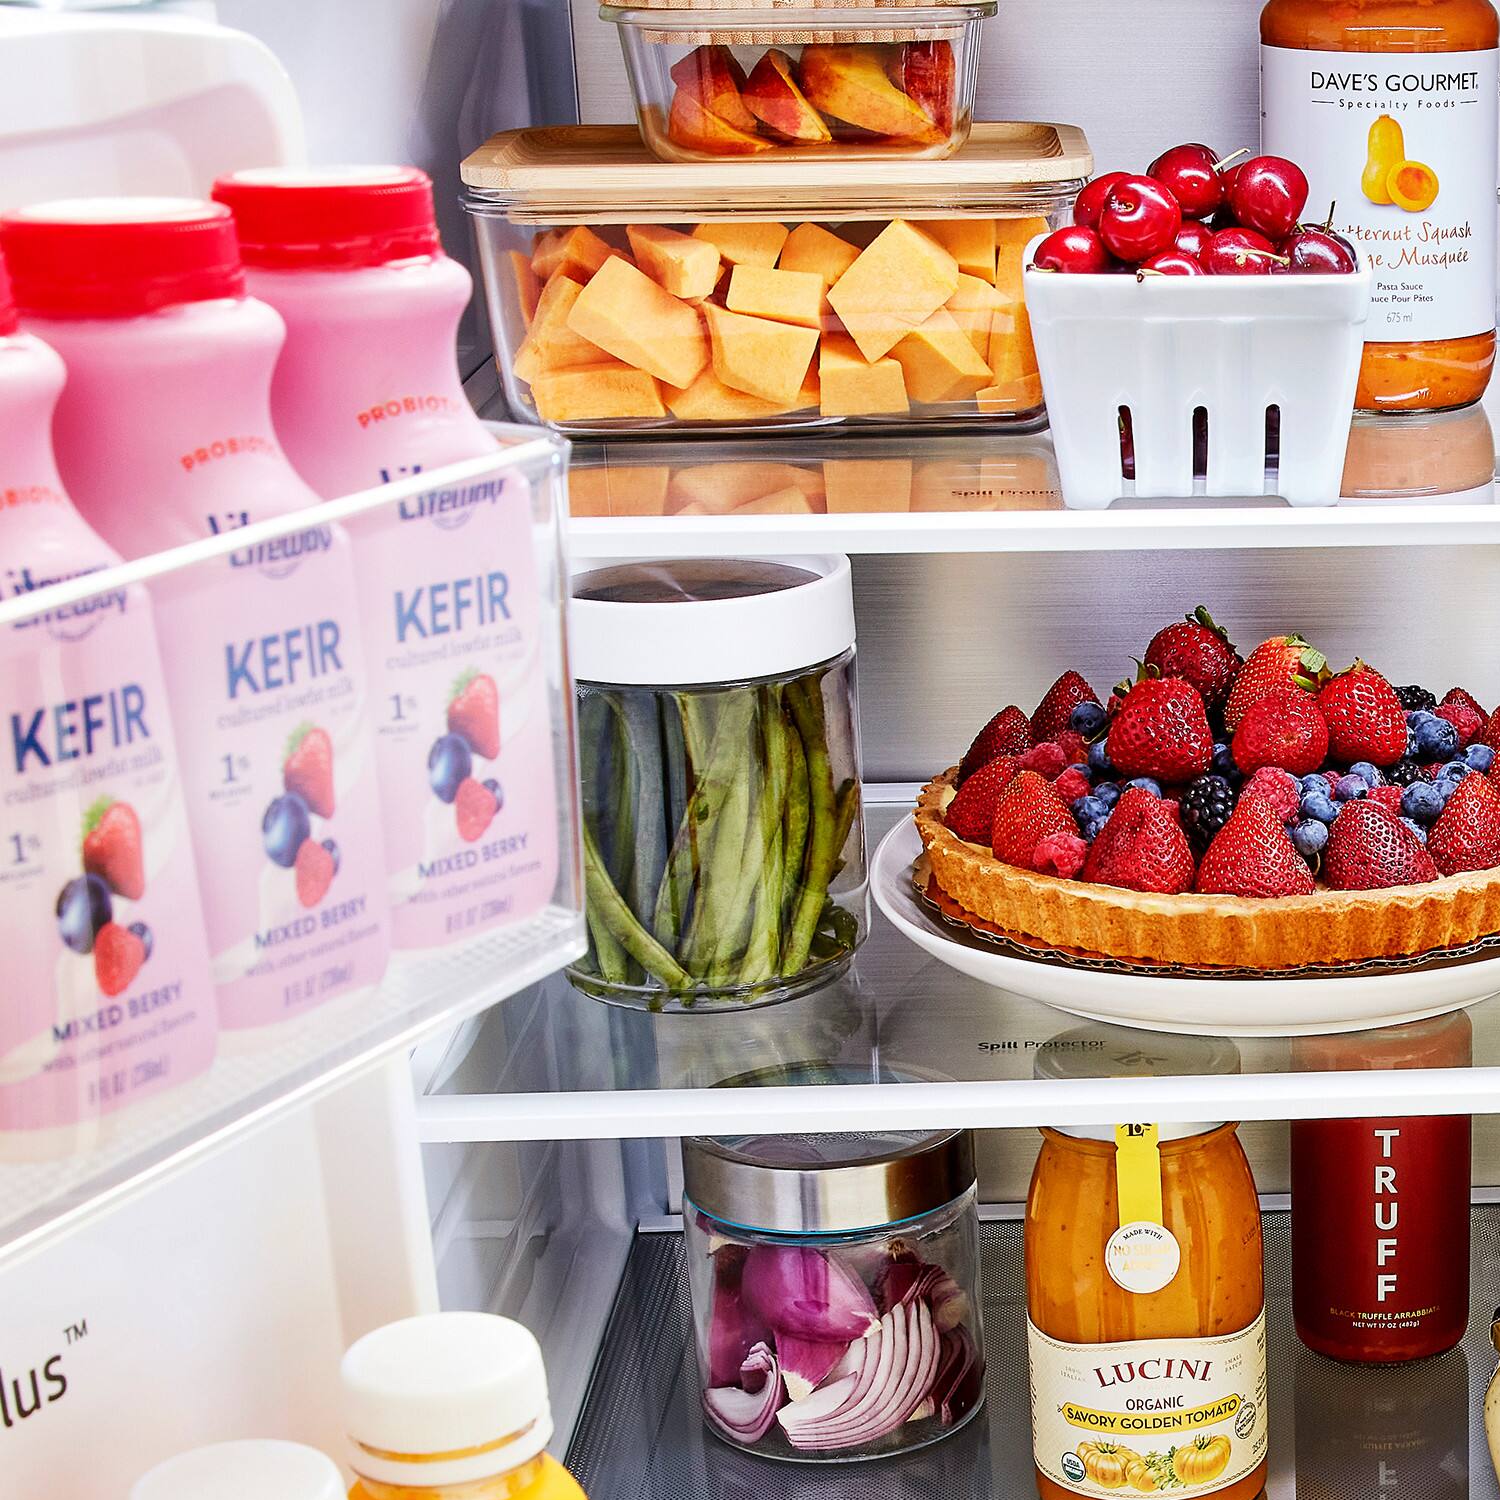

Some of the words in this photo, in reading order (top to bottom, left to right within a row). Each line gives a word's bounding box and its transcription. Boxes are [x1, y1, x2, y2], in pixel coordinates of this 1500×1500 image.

[1311, 71, 1378, 91] DAVE'S
[1339, 99, 1409, 110] Specialty
[1418, 99, 1455, 109] Foods
[1417, 221, 1472, 245] Squash
[1388, 247, 1469, 269] Musquée
[1377, 283, 1398, 291] Pasta
[1401, 282, 1424, 291] Sauce
[1391, 294, 1411, 303] Pour
[1387, 312, 1401, 323] 675
[394, 571, 511, 643] KEFIR
[225, 619, 343, 700] KEFIR
[10, 684, 150, 774] KEFIR
[418, 850, 478, 878] MIXED
[481, 832, 528, 862] BERRY
[52, 1004, 123, 1042] MIXED
[977, 1041, 1018, 1051] Spill
[1024, 1039, 1107, 1050] Protector
[1374, 1128, 1400, 1303] TRUFF
[1122, 1229, 1143, 1241] MADE
[1144, 1228, 1163, 1241] WITH
[1358, 1312, 1392, 1320] TRUFFLE
[1093, 1358, 1212, 1388] LUCINI
[0, 1355, 68, 1428] lus
[1067, 1407, 1117, 1428] SAVORY
[1120, 1415, 1183, 1430] GOLDEN
[1185, 1398, 1238, 1423] TOMATO
[1126, 1396, 1184, 1411] ORGANIC
